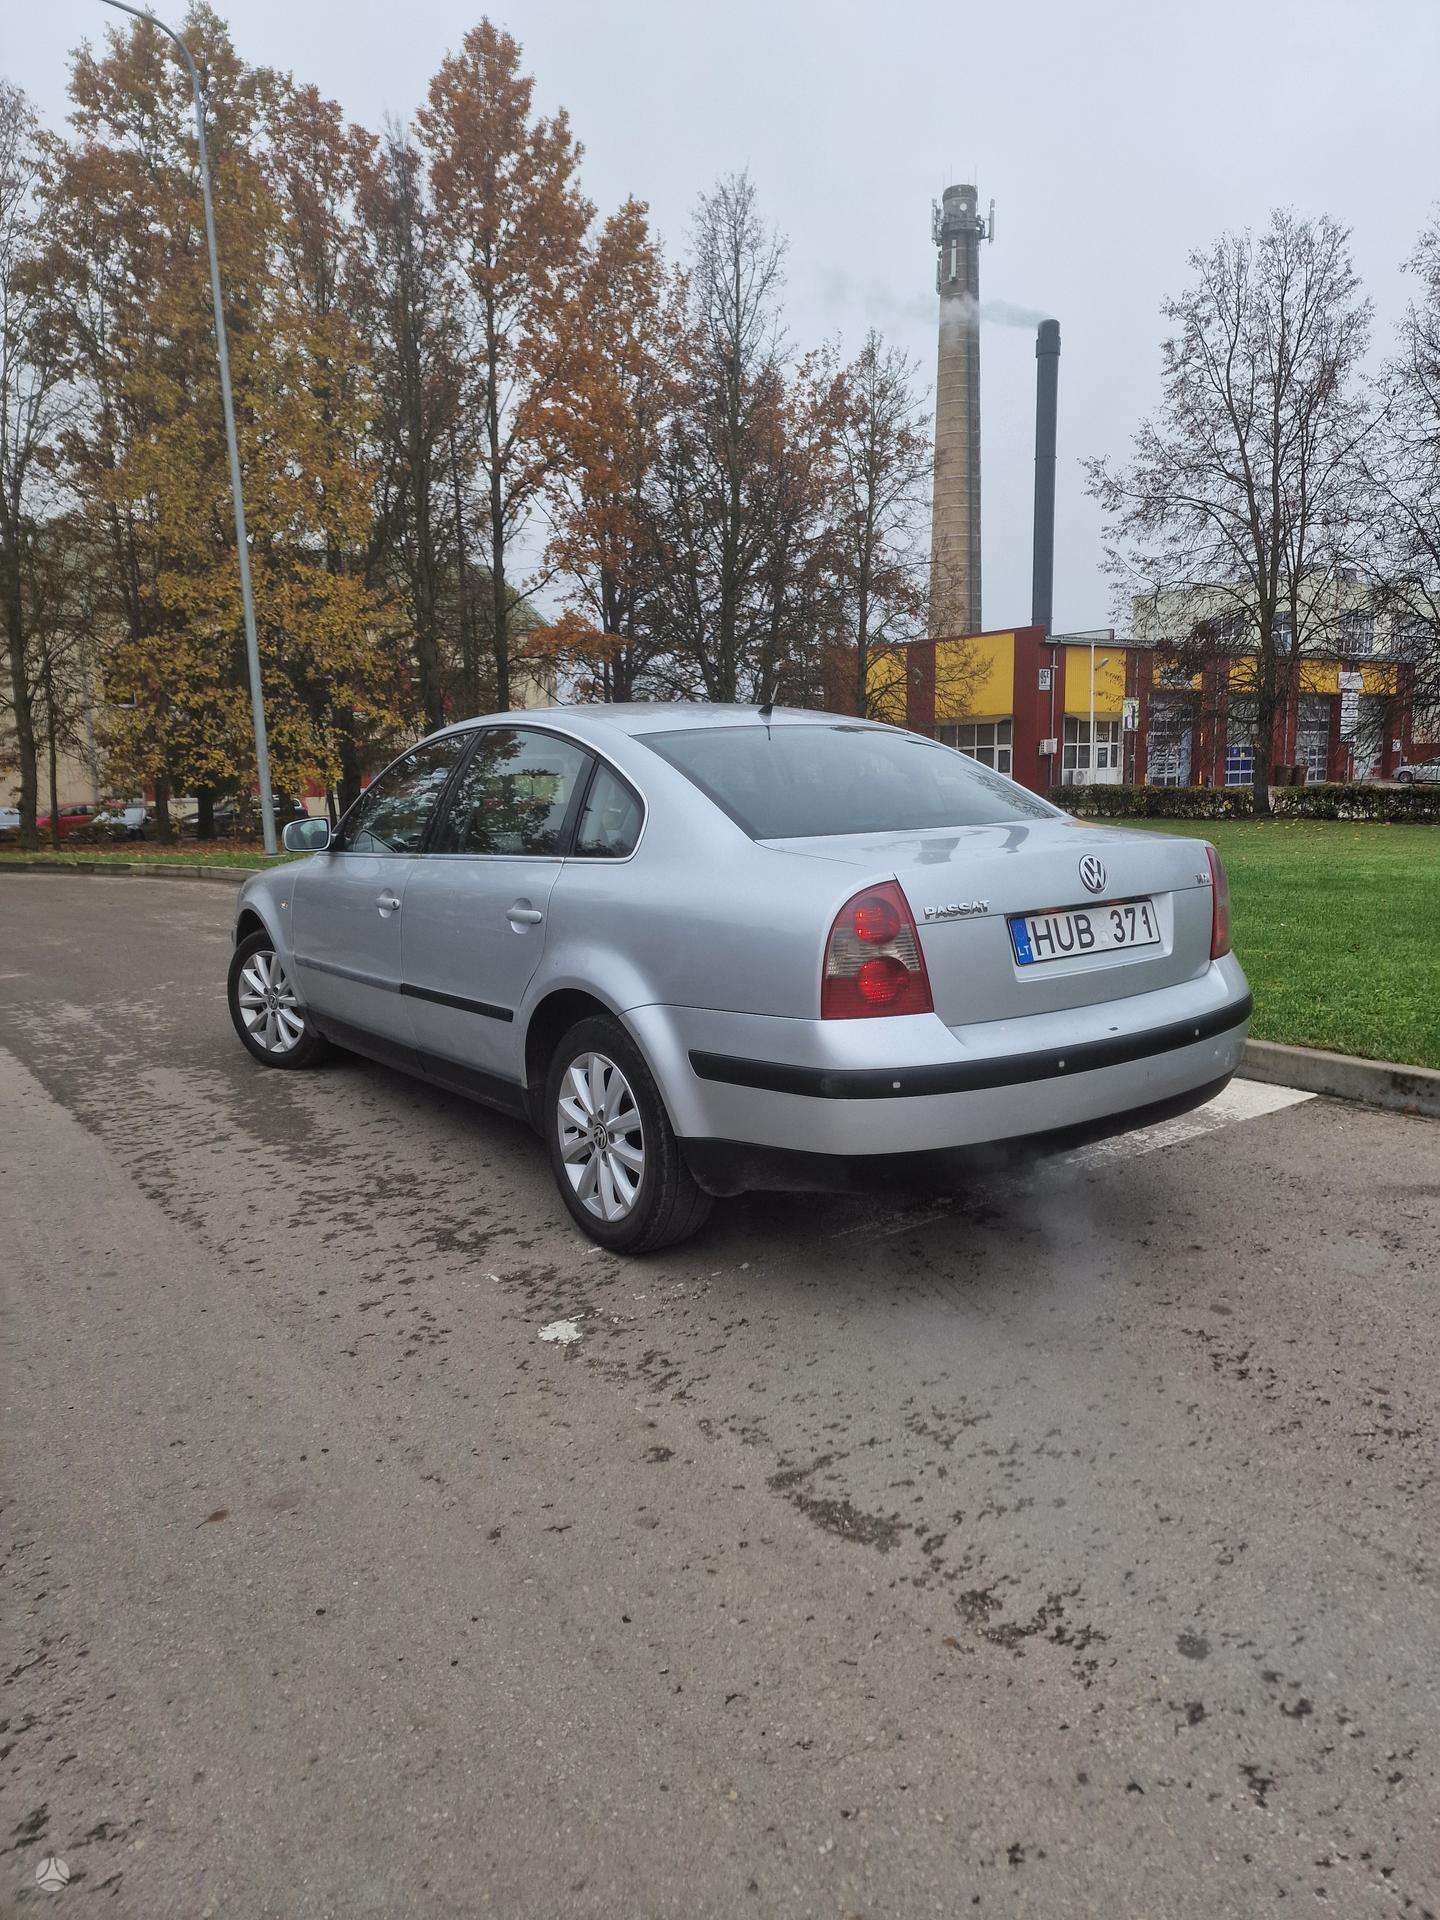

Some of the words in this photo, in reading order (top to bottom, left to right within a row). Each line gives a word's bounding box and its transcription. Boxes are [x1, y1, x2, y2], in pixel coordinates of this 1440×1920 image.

[923, 900, 990, 920] PASSAT
[1031, 913, 1095, 956] HUB
[1109, 905, 1153, 943] 371
[1018, 945, 1030, 957] LT
